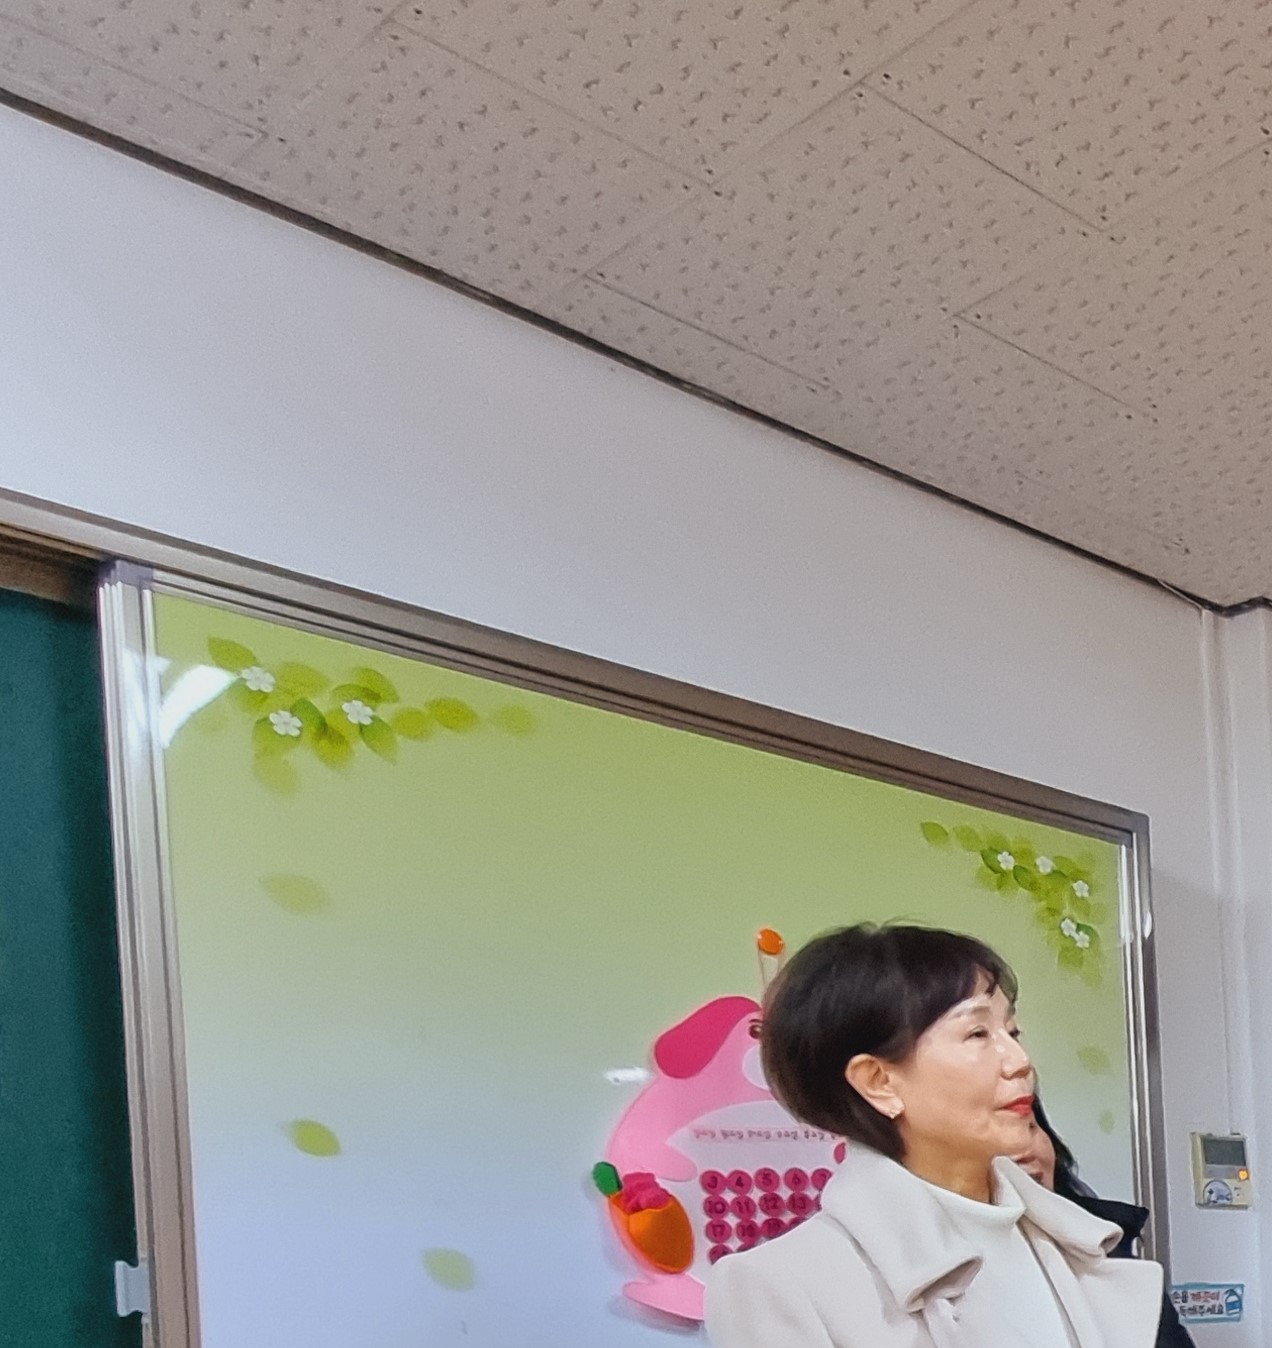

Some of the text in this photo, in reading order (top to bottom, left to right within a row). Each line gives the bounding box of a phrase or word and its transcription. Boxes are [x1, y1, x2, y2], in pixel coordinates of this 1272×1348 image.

[708, 1175, 718, 1189] 3
[736, 1176, 744, 1187] 4
[761, 1172, 773, 1186] 5
[791, 1173, 802, 1186] 6
[708, 1196, 807, 1214] 10 11 12 13
[711, 1224, 726, 1238] 17
